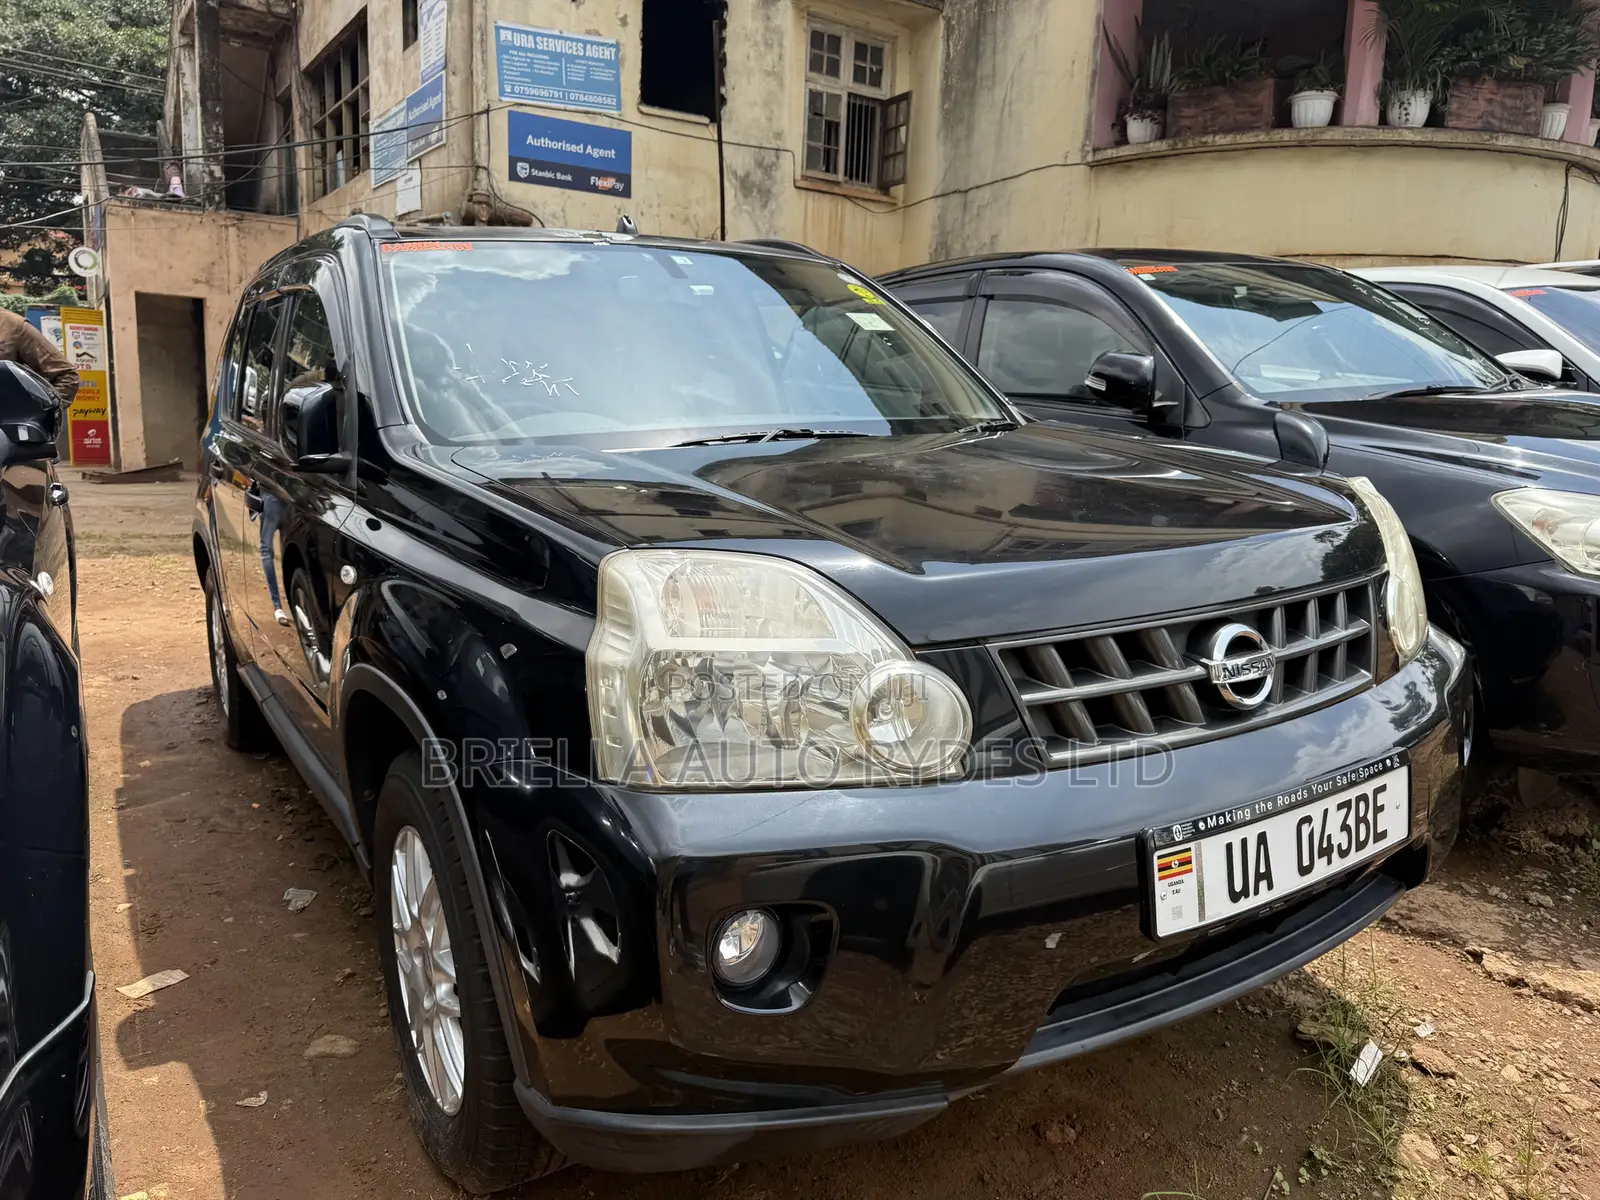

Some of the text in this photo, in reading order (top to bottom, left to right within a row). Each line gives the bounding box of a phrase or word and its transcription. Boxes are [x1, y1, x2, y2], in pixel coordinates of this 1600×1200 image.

[513, 32, 617, 60] URA SERVICES AGENT
[408, 92, 442, 121] Authorised Agent
[526, 134, 616, 159] Authorised Agent
[531, 168, 573, 182] Stanbic Bank
[590, 175, 625, 192] FlexiPay
[1220, 653, 1276, 680] NISSAN
[1207, 761, 1384, 829] Making the Roads Your Safe Space
[1225, 783, 1388, 904] UA 043BE
[1168, 879, 1185, 888] UGANDA
